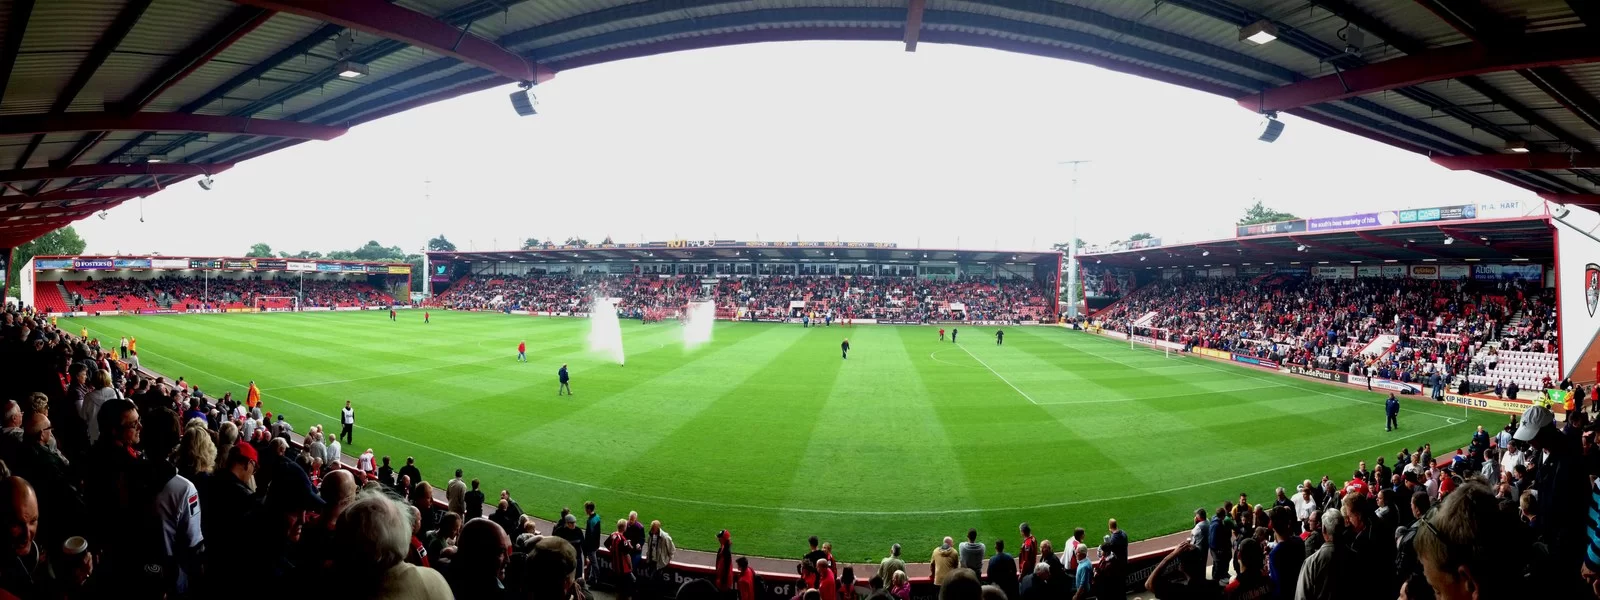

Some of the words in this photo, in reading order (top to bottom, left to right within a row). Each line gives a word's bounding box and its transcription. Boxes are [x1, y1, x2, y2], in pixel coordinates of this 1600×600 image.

[1456, 397, 1472, 405] HIRE
[1474, 399, 1488, 408] LTD
[774, 584, 790, 595] of
